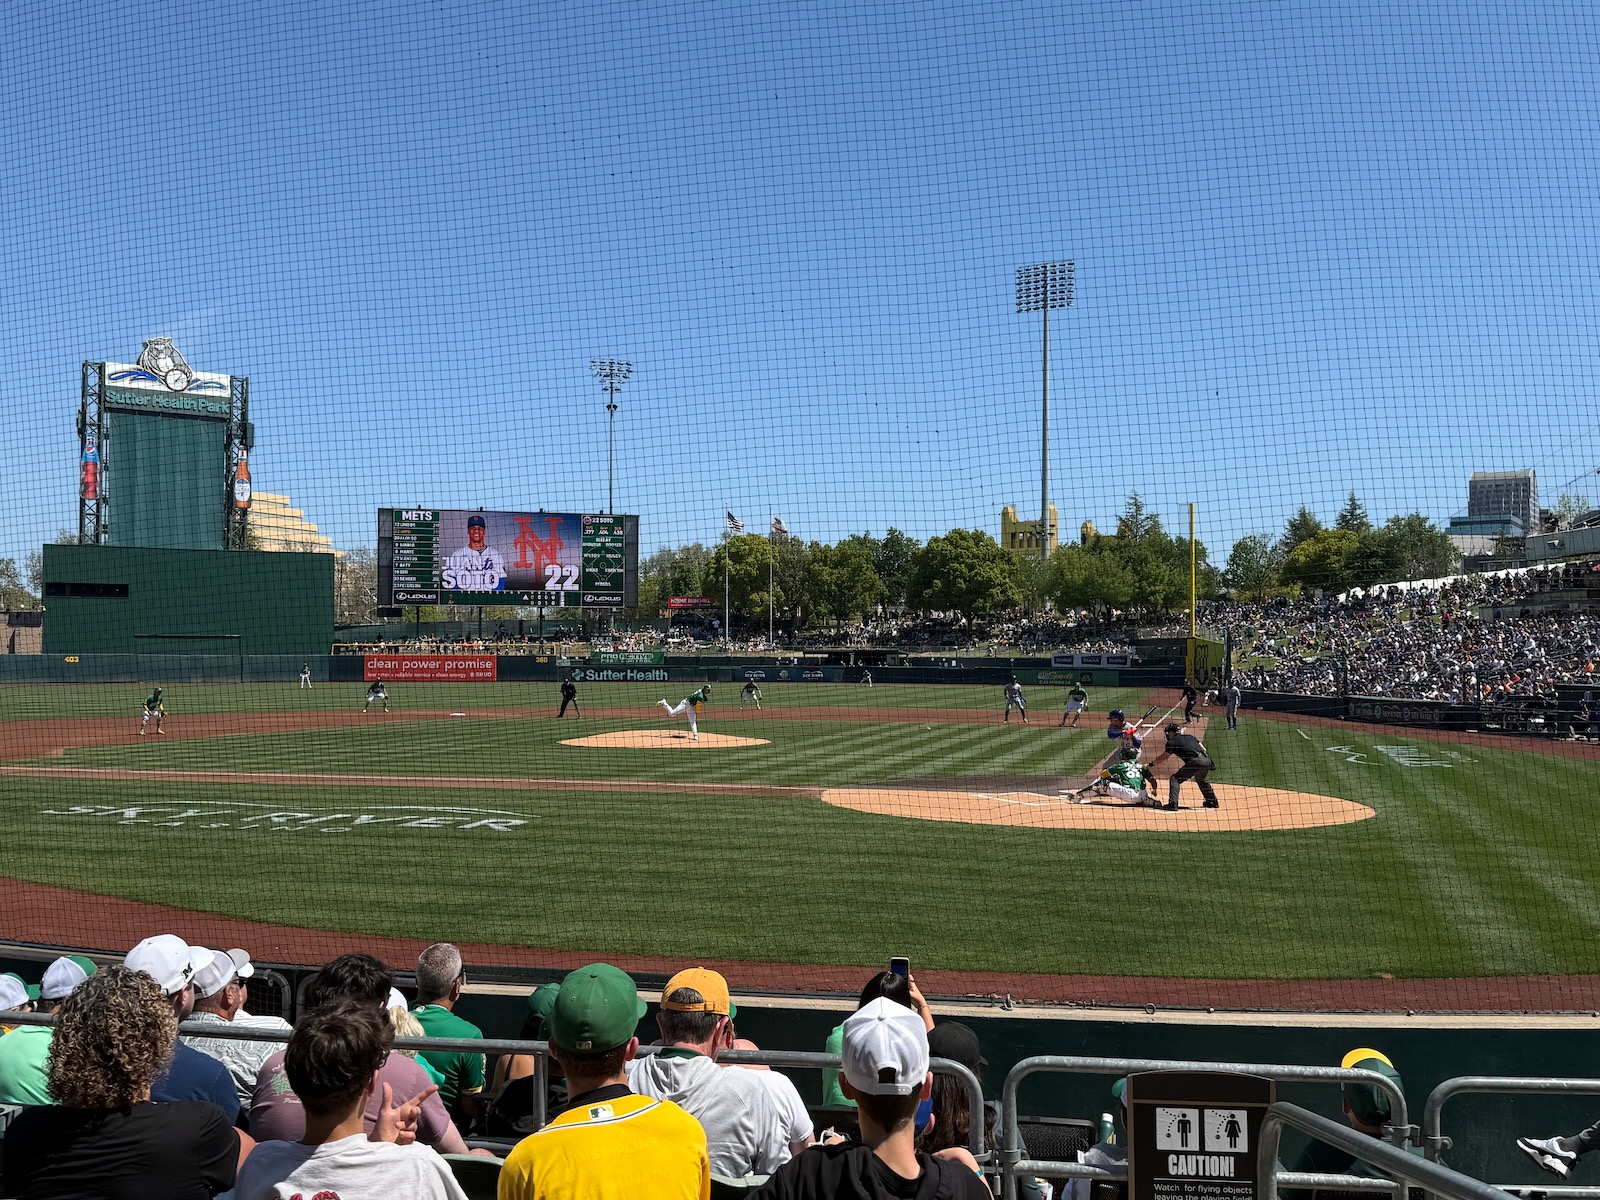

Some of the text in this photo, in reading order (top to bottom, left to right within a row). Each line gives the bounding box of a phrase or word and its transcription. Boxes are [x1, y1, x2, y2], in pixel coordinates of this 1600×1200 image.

[105, 389, 231, 414] Sutter Health Park
[401, 511, 433, 521] METS
[441, 557, 483, 569] JUAN
[441, 569, 500, 589] SOTO
[544, 564, 579, 590] 22
[367, 658, 493, 671] clean power promise
[585, 669, 668, 681] Sutter Health
[1048, 671, 1074, 680] Sports
[240, 812, 529, 832] RIVER
[1167, 1154, 1235, 1178] CAUTION!
[1153, 1183, 1253, 1195] Watch for flying objects
